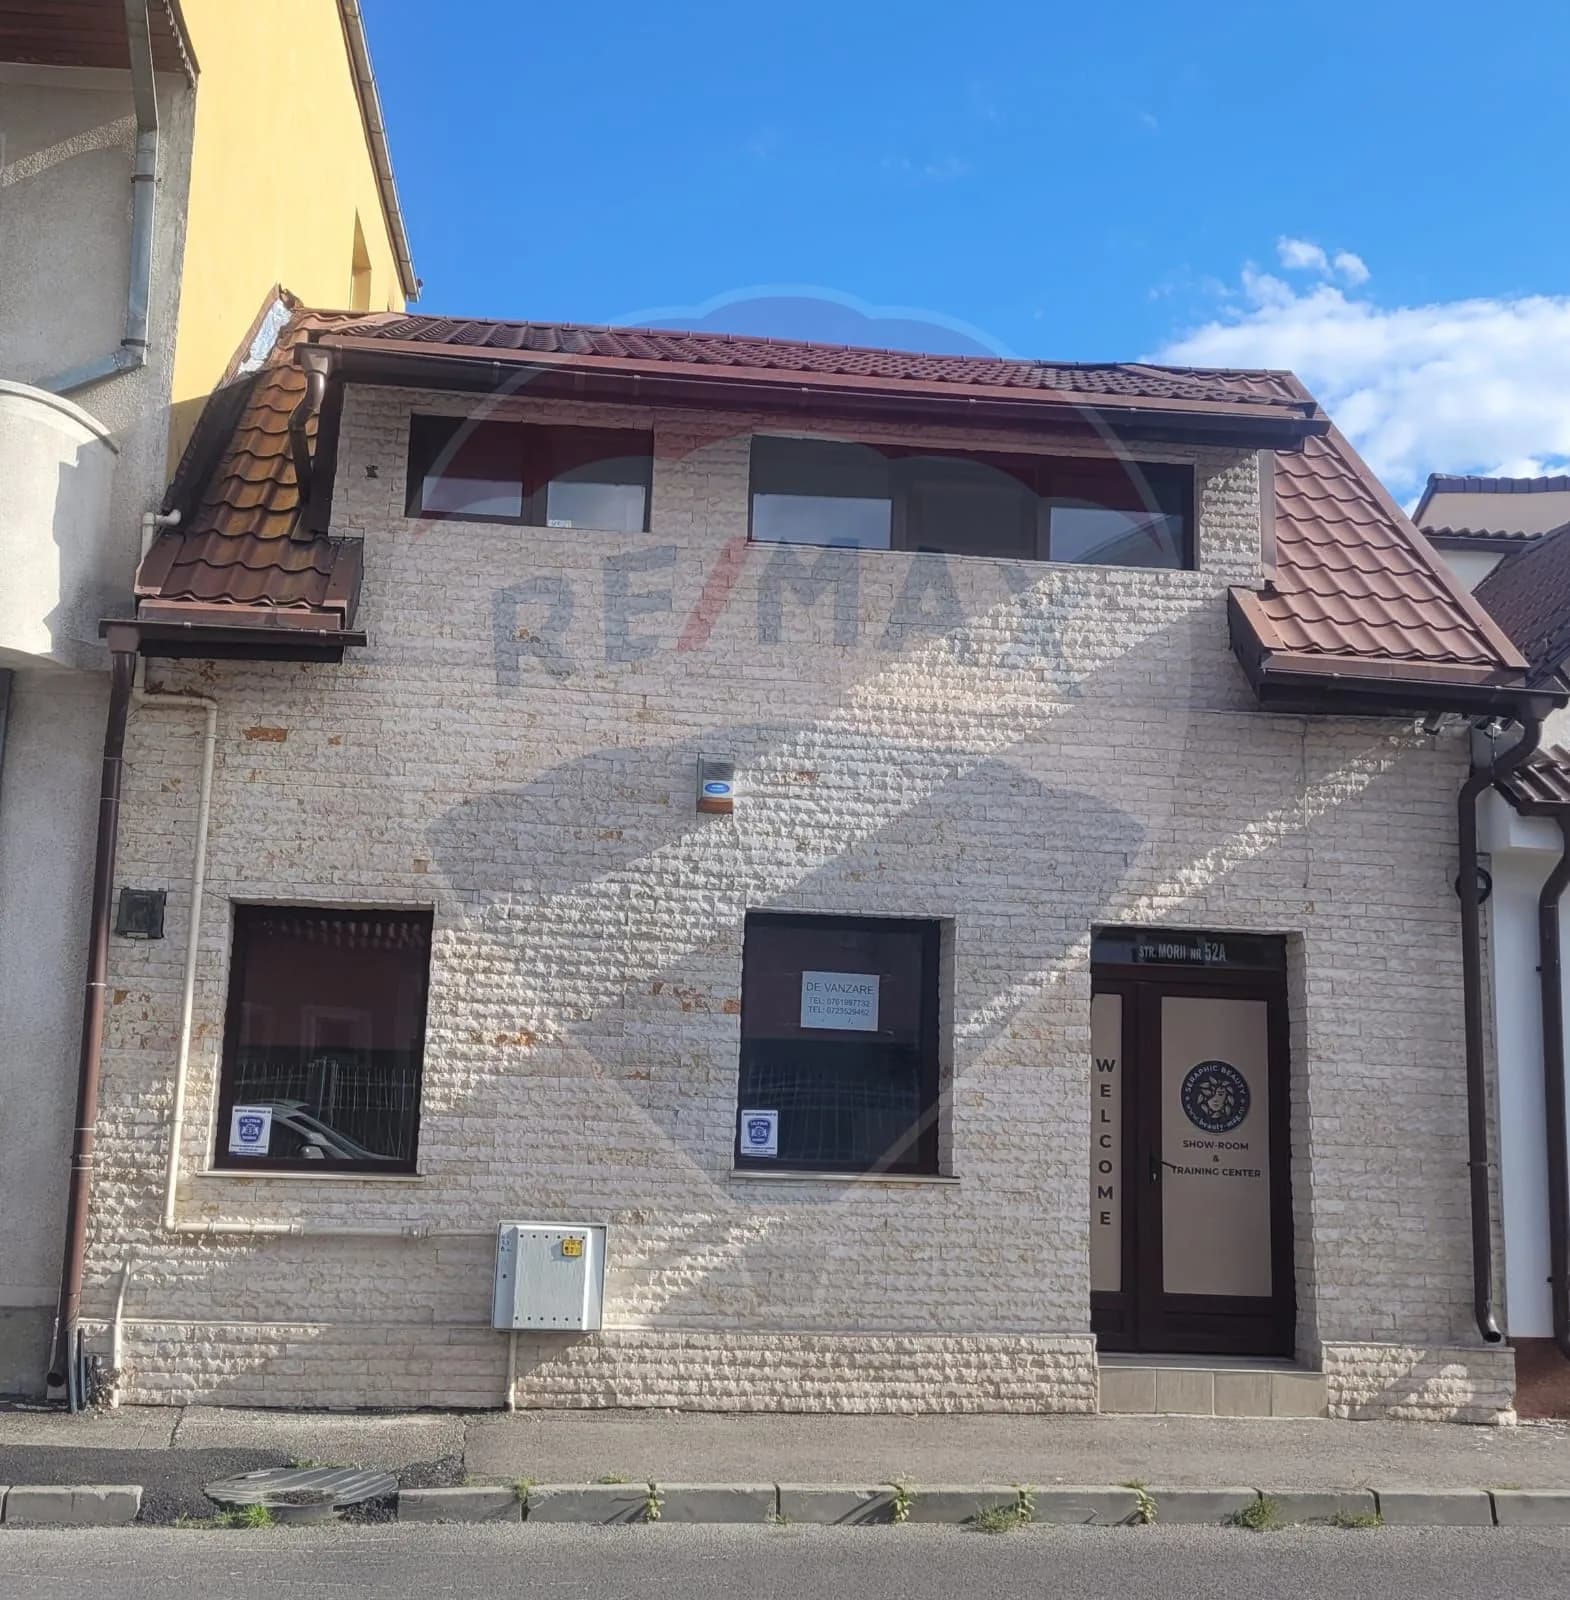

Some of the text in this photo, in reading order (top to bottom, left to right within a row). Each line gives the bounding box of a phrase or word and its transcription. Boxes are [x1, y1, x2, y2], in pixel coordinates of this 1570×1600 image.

[1158, 944, 1186, 960] MORII
[1204, 943, 1227, 962] 52A
[806, 982, 874, 995] DE VANZARE
[808, 997, 824, 1005] TEL:
[808, 1006, 824, 1014] TEL:
[1185, 1064, 1247, 1095] SERAPHIC BEAUTY
[1096, 1058, 1116, 1225] WELCOME
[1183, 1140, 1249, 1151] SHOW-ROOM
[1213, 1154, 1220, 1162] &
[1172, 1166, 1261, 1178] TRAINING CENTER
